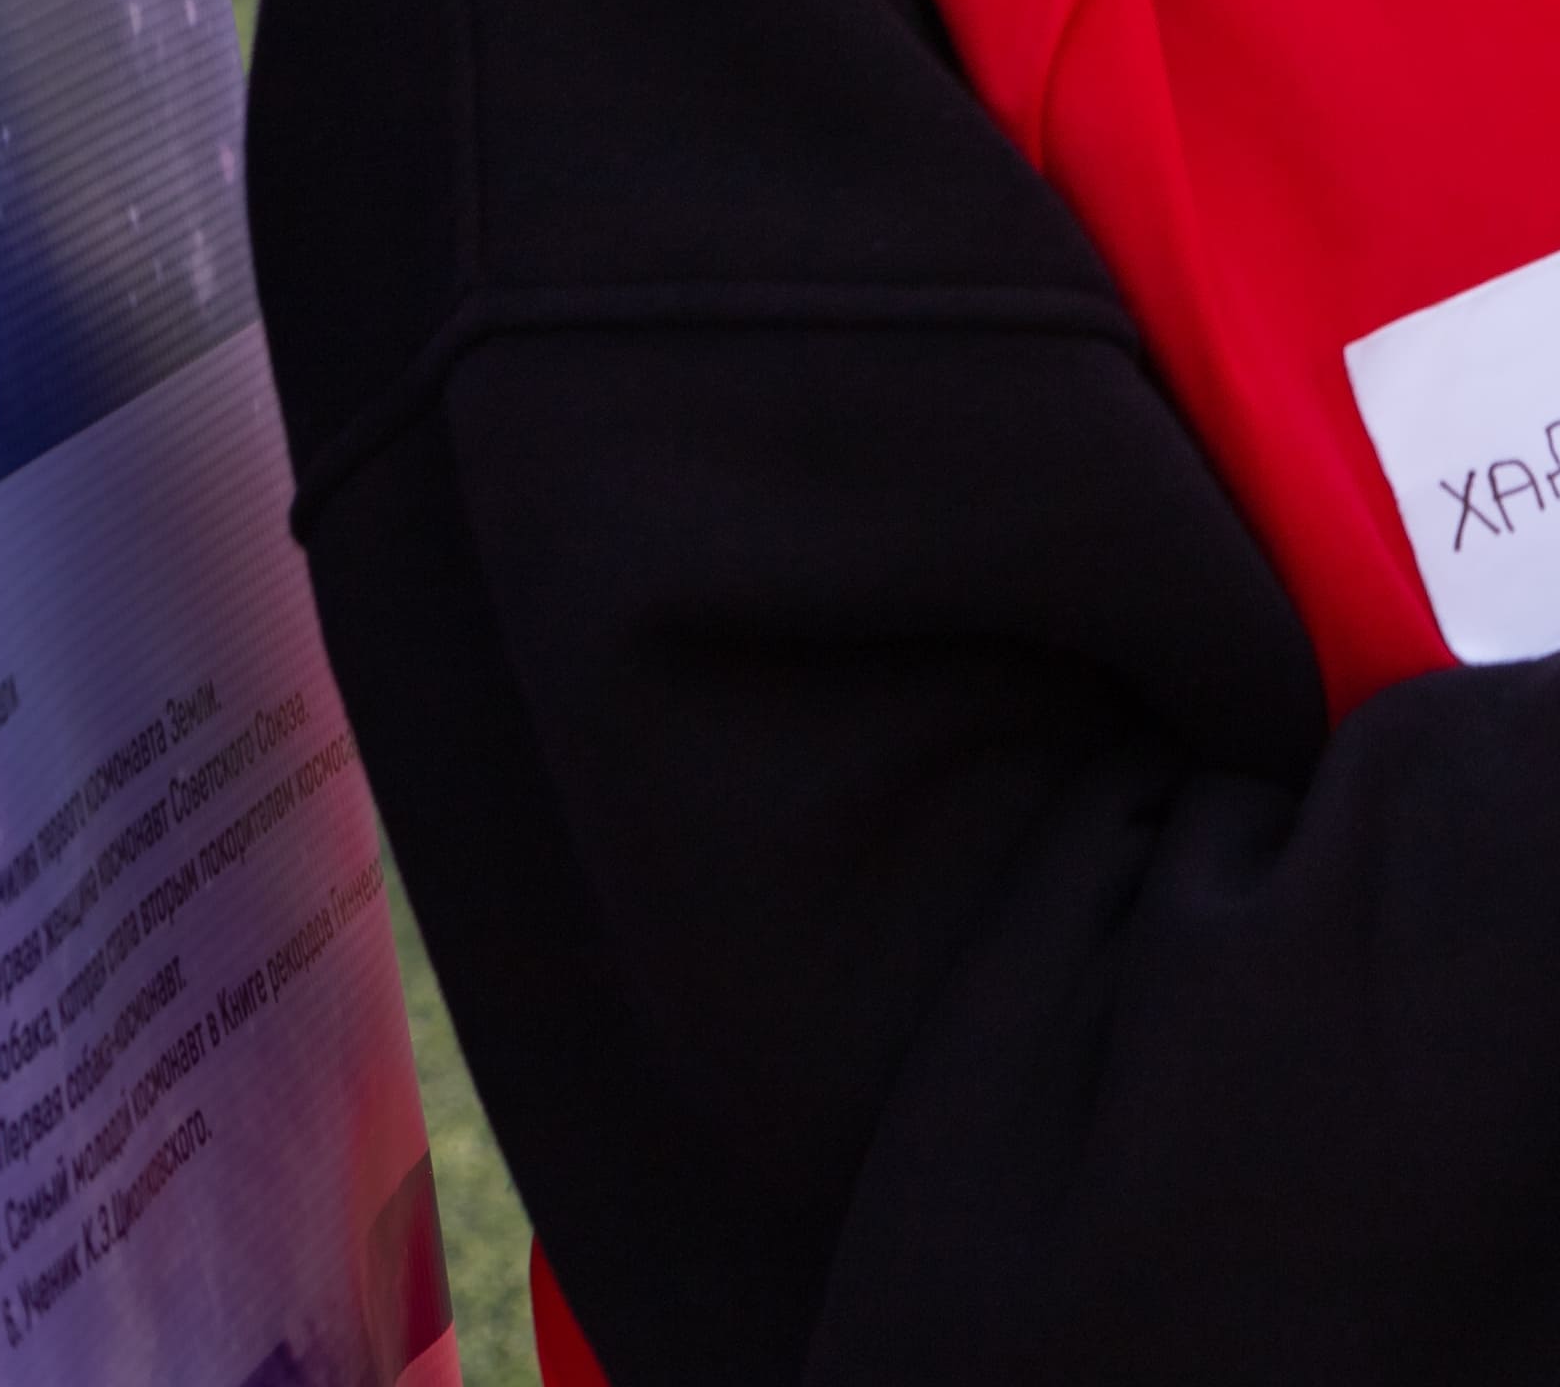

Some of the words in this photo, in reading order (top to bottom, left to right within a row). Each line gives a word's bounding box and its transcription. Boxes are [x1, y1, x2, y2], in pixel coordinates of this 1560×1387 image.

[83, 718, 167, 815] космонавта
[166, 679, 222, 745] Земли.
[97, 797, 169, 889] космонавт
[169, 730, 255, 825] Советского
[255, 692, 311, 755] Союза.
[139, 857, 199, 937] вторым
[198, 776, 296, 883] покорителем
[5, 1155, 70, 1253] Самый
[132, 1022, 207, 1121] космонавт
[206, 1011, 221, 1048] в
[217, 969, 268, 1036] Книге
[266, 907, 334, 1004] рекордов
